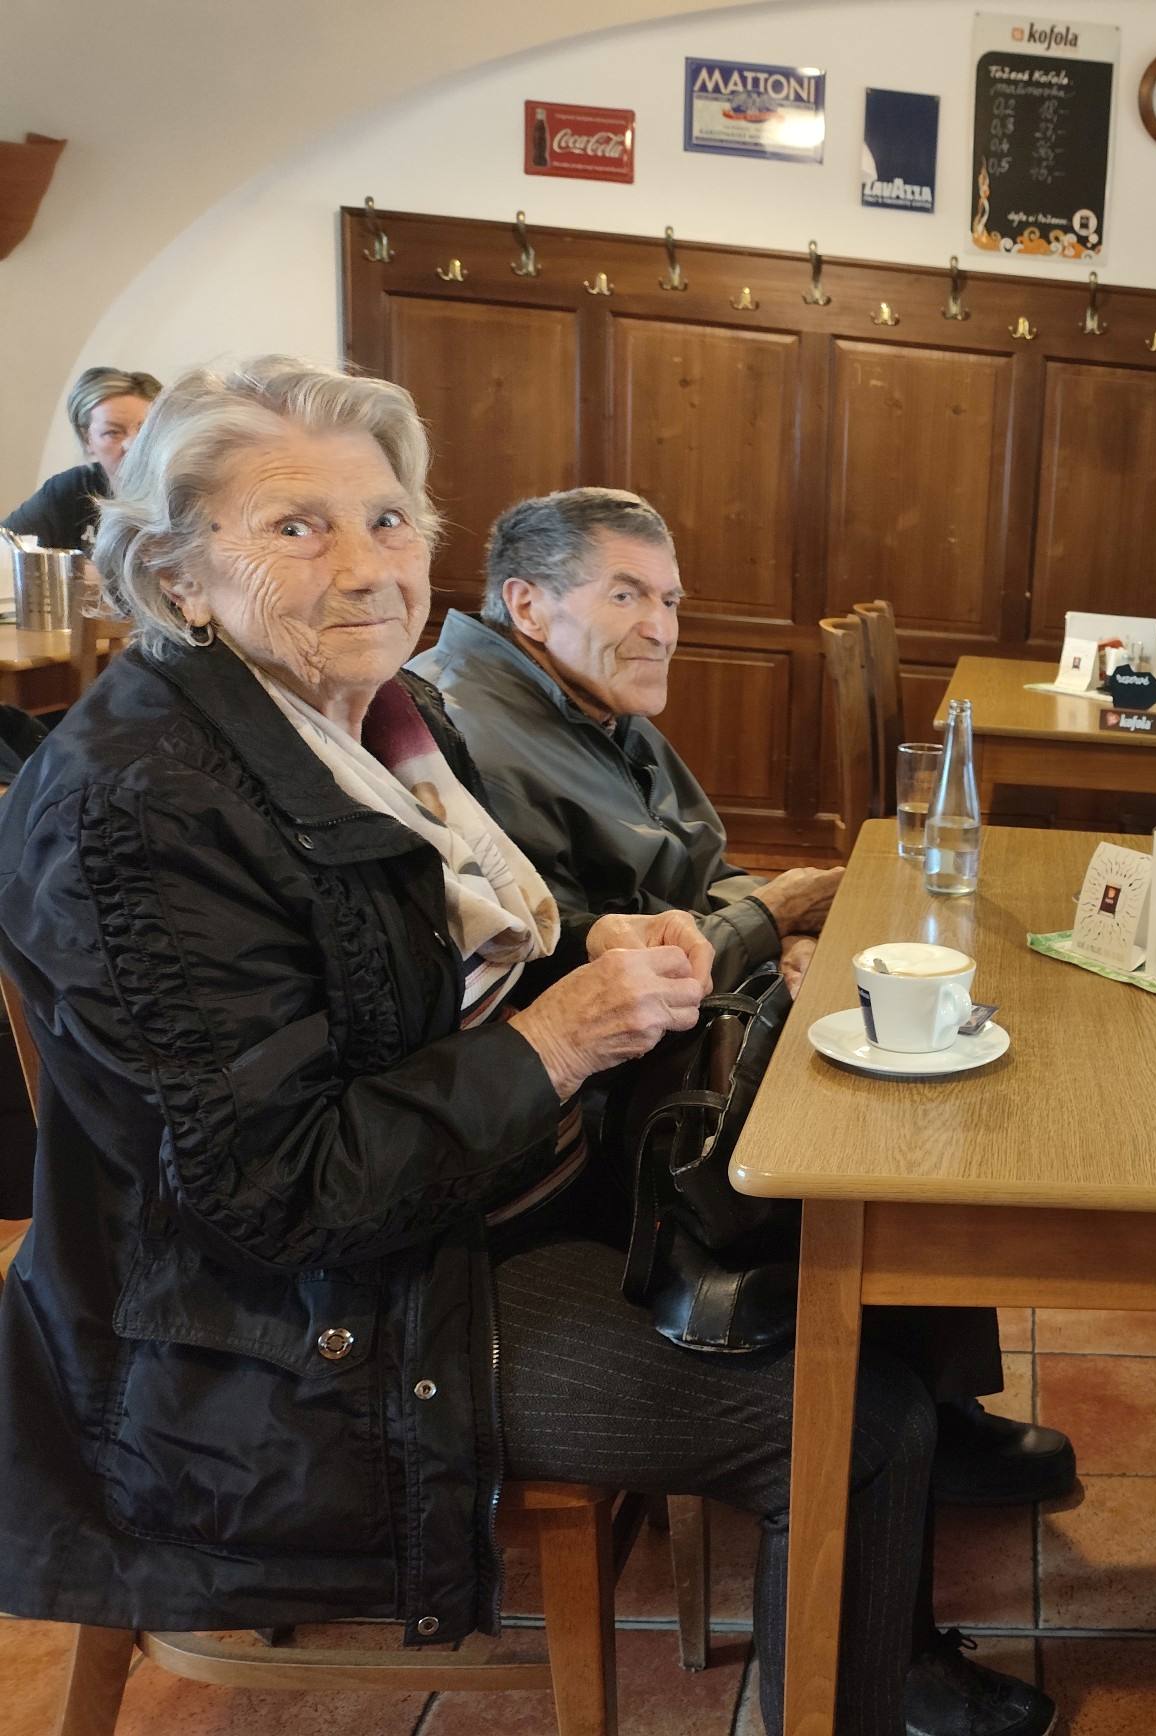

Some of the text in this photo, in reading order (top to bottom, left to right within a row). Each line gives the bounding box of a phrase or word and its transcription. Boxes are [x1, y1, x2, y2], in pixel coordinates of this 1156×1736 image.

[1027, 22, 1079, 51] kofola
[693, 66, 816, 104] MATTONI
[552, 127, 625, 158] Coca-Cola
[863, 177, 933, 202] LAVAZZA
